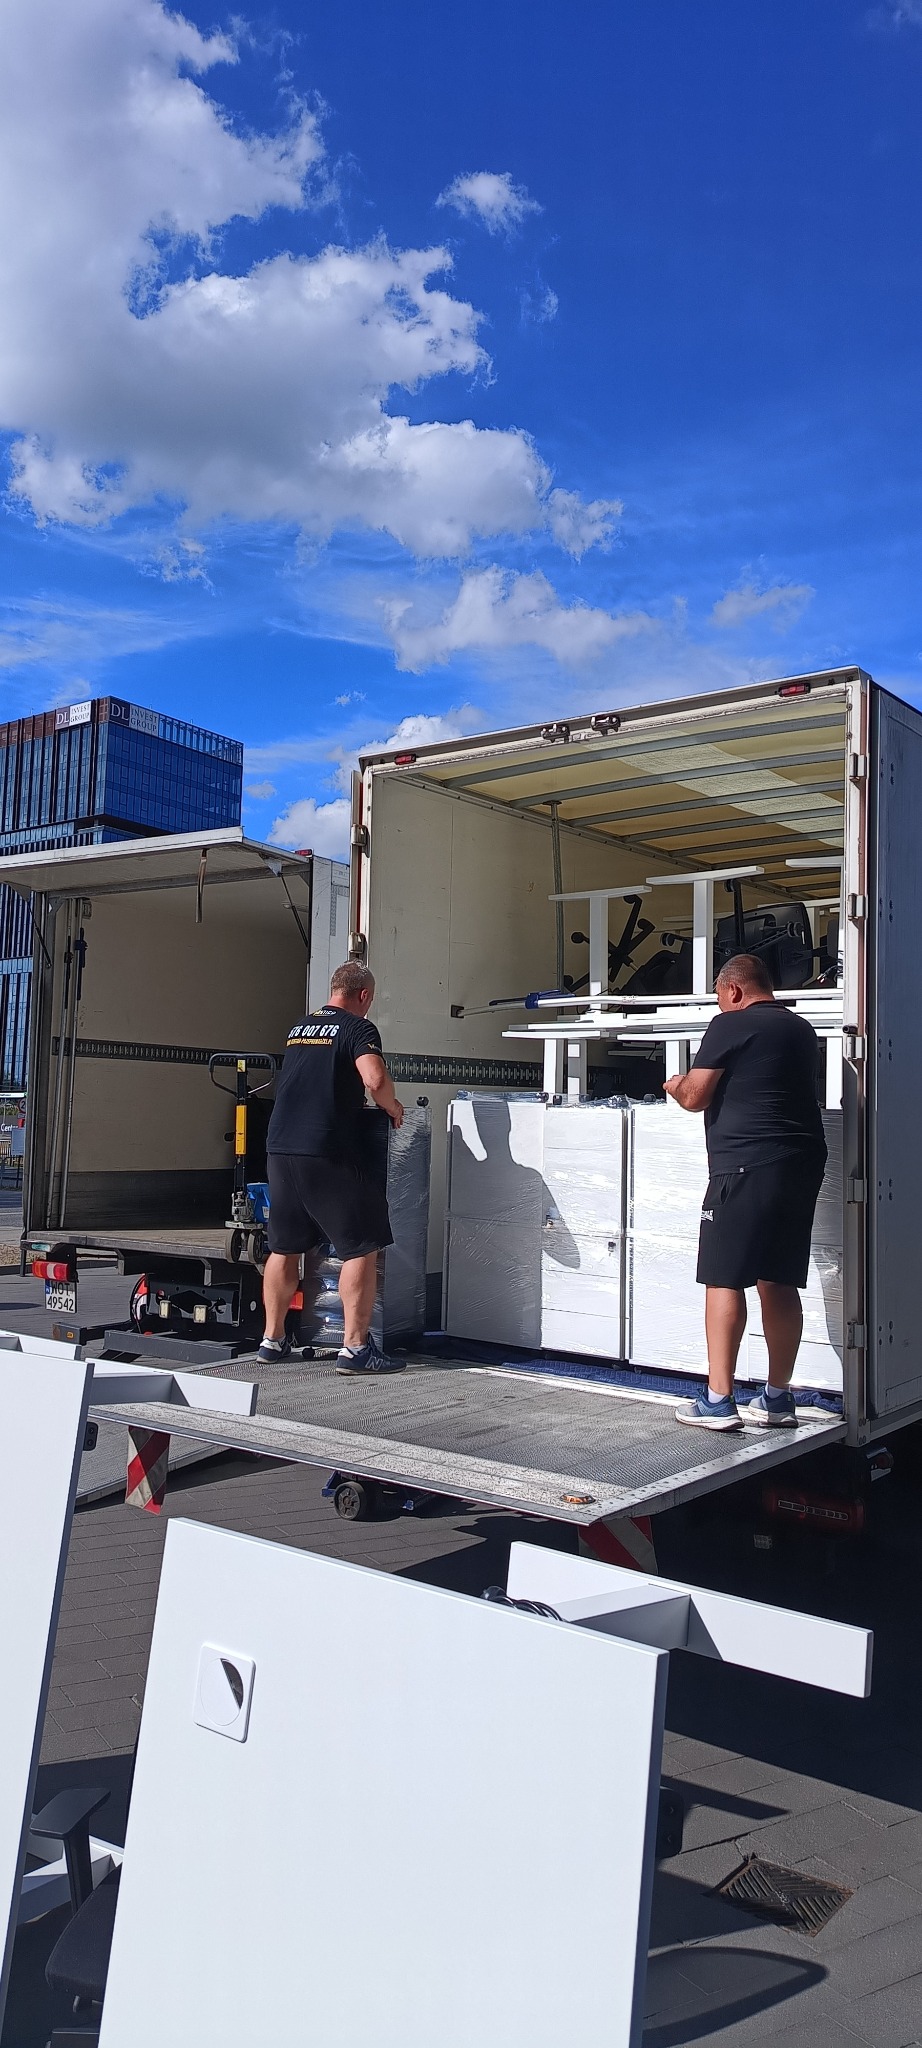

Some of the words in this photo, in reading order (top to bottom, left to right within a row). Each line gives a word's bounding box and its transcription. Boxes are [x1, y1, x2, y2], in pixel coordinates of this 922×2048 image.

[71, 704, 90, 715] INVEST
[111, 702, 129, 721] DL
[131, 708, 157, 724] INVEST
[56, 712, 69, 725] DL
[70, 712, 90, 723] GROUP
[131, 718, 157, 732] GROUP
[302, 1024, 321, 1037] 007
[319, 1024, 340, 1037] 676
[51, 1281, 70, 1296] WOT
[47, 1296, 74, 1311] 49542
[365, 1355, 384, 1371] N
